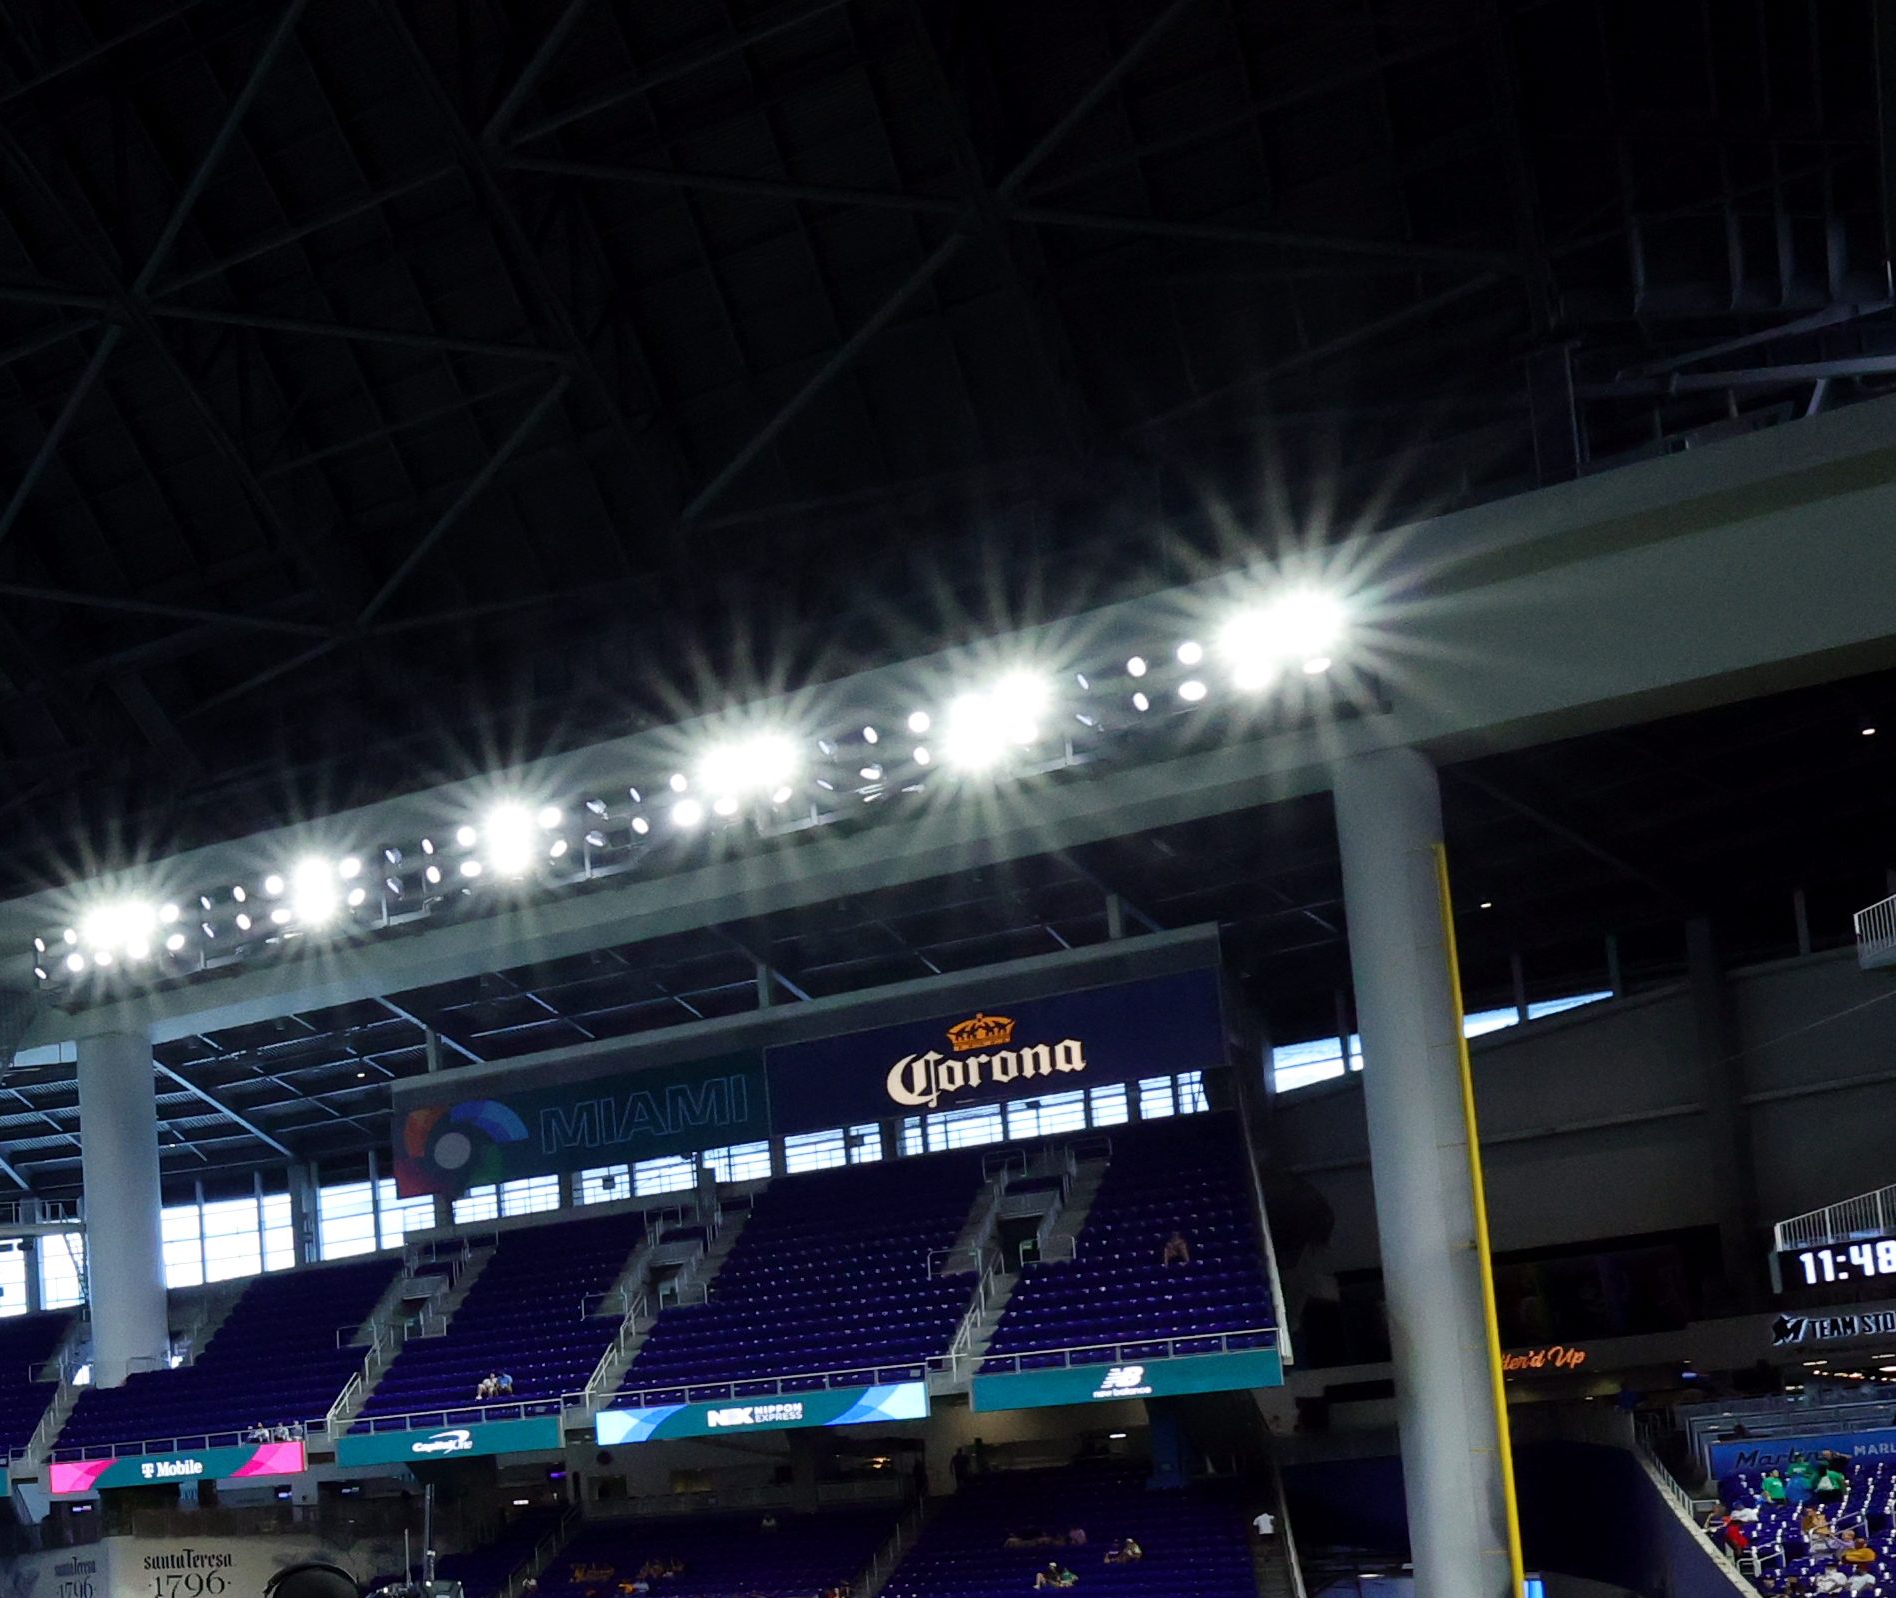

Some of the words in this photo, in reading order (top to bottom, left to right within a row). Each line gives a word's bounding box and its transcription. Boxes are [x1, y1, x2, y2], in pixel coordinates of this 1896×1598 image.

[886, 1037, 1087, 1109] Corona
[538, 1073, 751, 1155] MIAMI
[1799, 1240, 1896, 1284] 11:48
[1809, 1315, 1860, 1339] TEAM
[1861, 1310, 1896, 1335] STO
[1547, 1345, 1587, 1369] Up
[1118, 1385, 1152, 1397] balance
[754, 1402, 802, 1414] NIPPON
[754, 1410, 802, 1422] EXPRESS
[1854, 1442, 1896, 1457] MARL
[156, 1459, 203, 1478] Mobile
